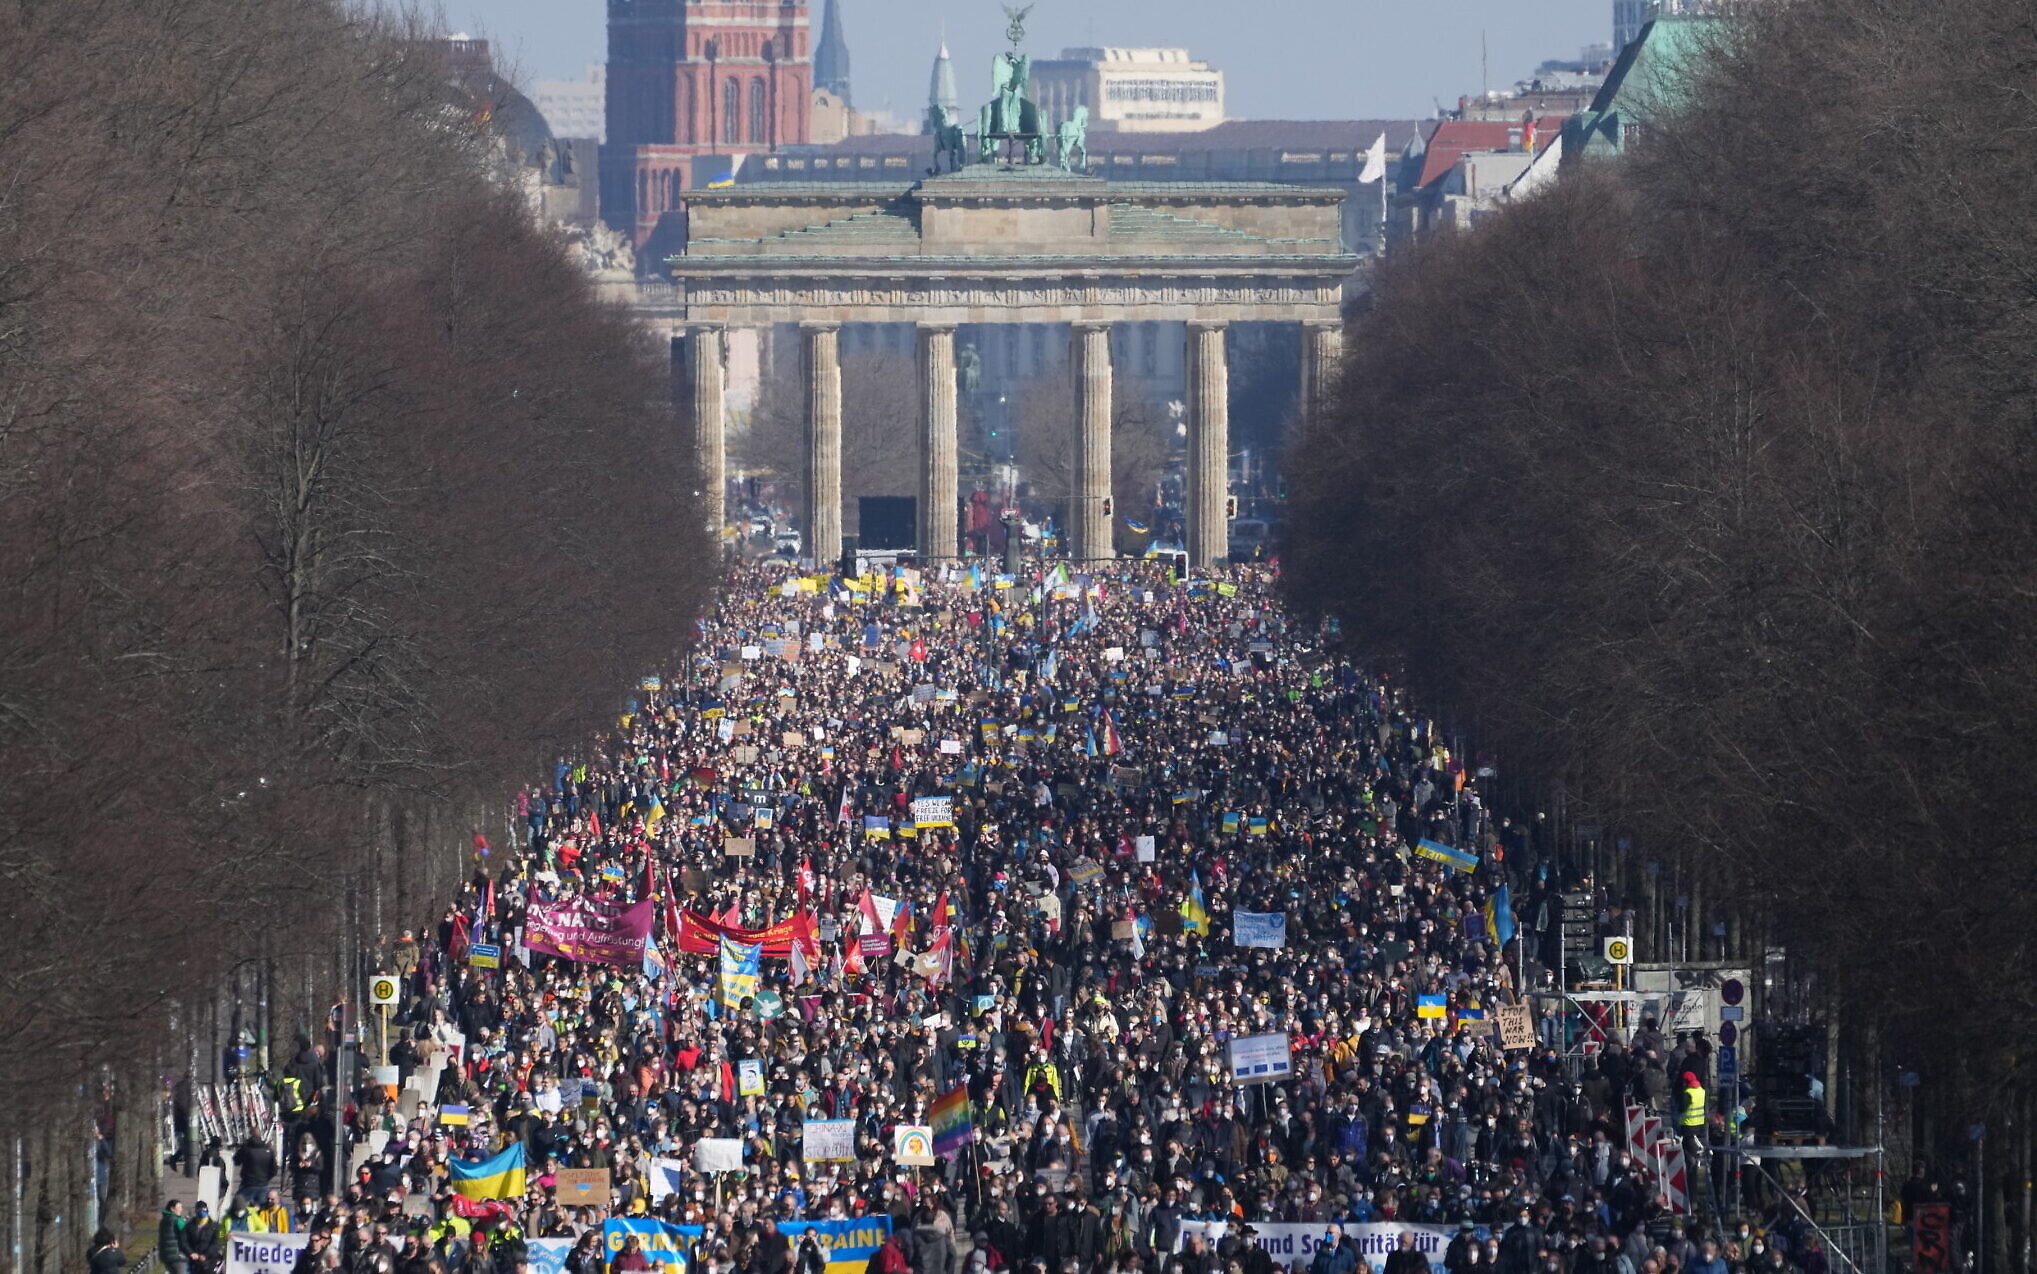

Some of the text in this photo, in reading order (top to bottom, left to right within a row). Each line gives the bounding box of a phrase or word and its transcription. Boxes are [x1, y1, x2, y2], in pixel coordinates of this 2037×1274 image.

[767, 925, 794, 936] Kriege
[567, 930, 586, 942] und
[587, 931, 645, 950] Aufrüstung!
[1615, 945, 1623, 955] H
[379, 984, 389, 995] H
[1501, 1006, 1526, 1017] STOP
[1502, 1017, 1523, 1026] THIS
[1505, 1026, 1524, 1035] WAR
[1505, 1033, 1534, 1044] NOW!!
[805, 1146, 830, 1158] STOP
[788, 1228, 886, 1250] RAINE
[1257, 1234, 1293, 1254] und
[1414, 1232, 1440, 1253] für
